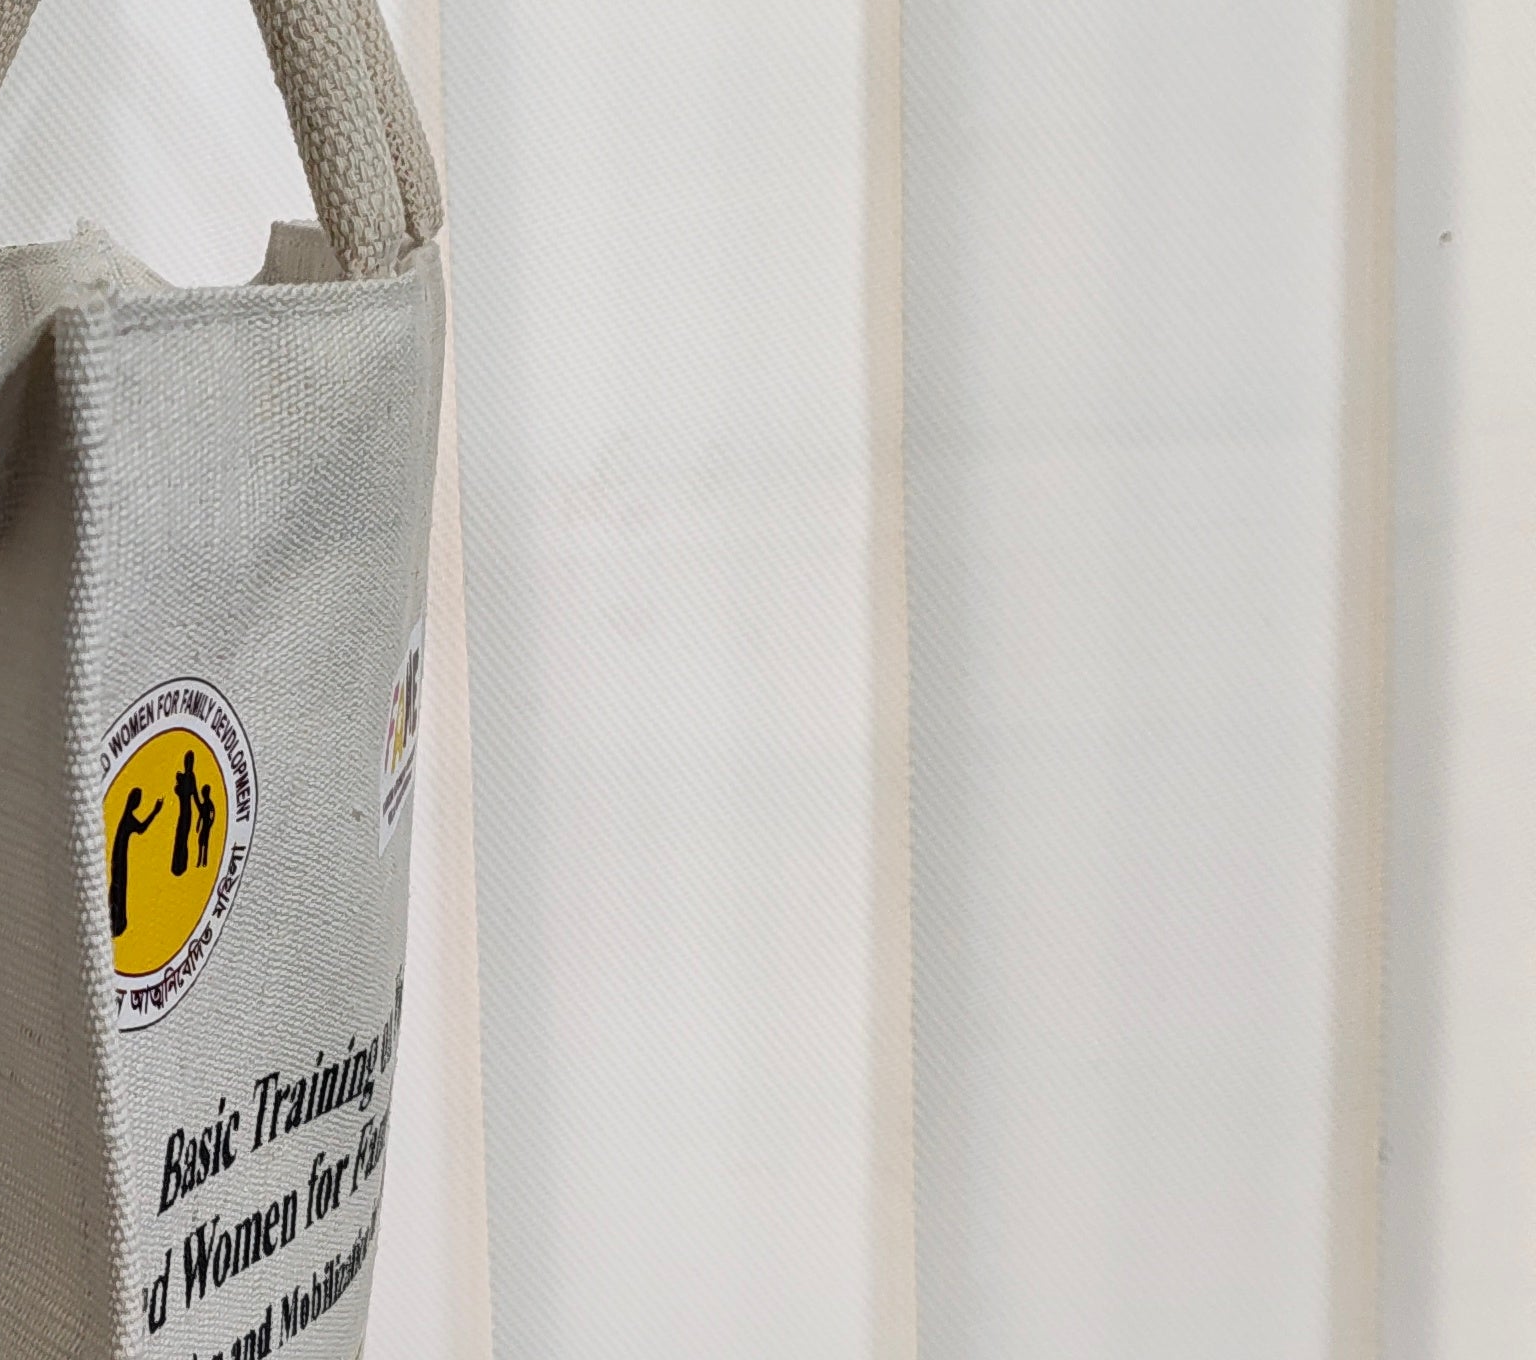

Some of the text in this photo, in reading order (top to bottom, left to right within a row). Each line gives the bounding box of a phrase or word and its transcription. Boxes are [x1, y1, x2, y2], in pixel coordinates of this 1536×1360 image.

[109, 699, 155, 758] WOMEN
[157, 690, 180, 720] FOR
[179, 689, 216, 724] FAMILY
[157, 1096, 240, 1217] Basic
[250, 1034, 379, 1153] Training
[183, 1189, 298, 1309] Women
[305, 1151, 350, 1230] for
